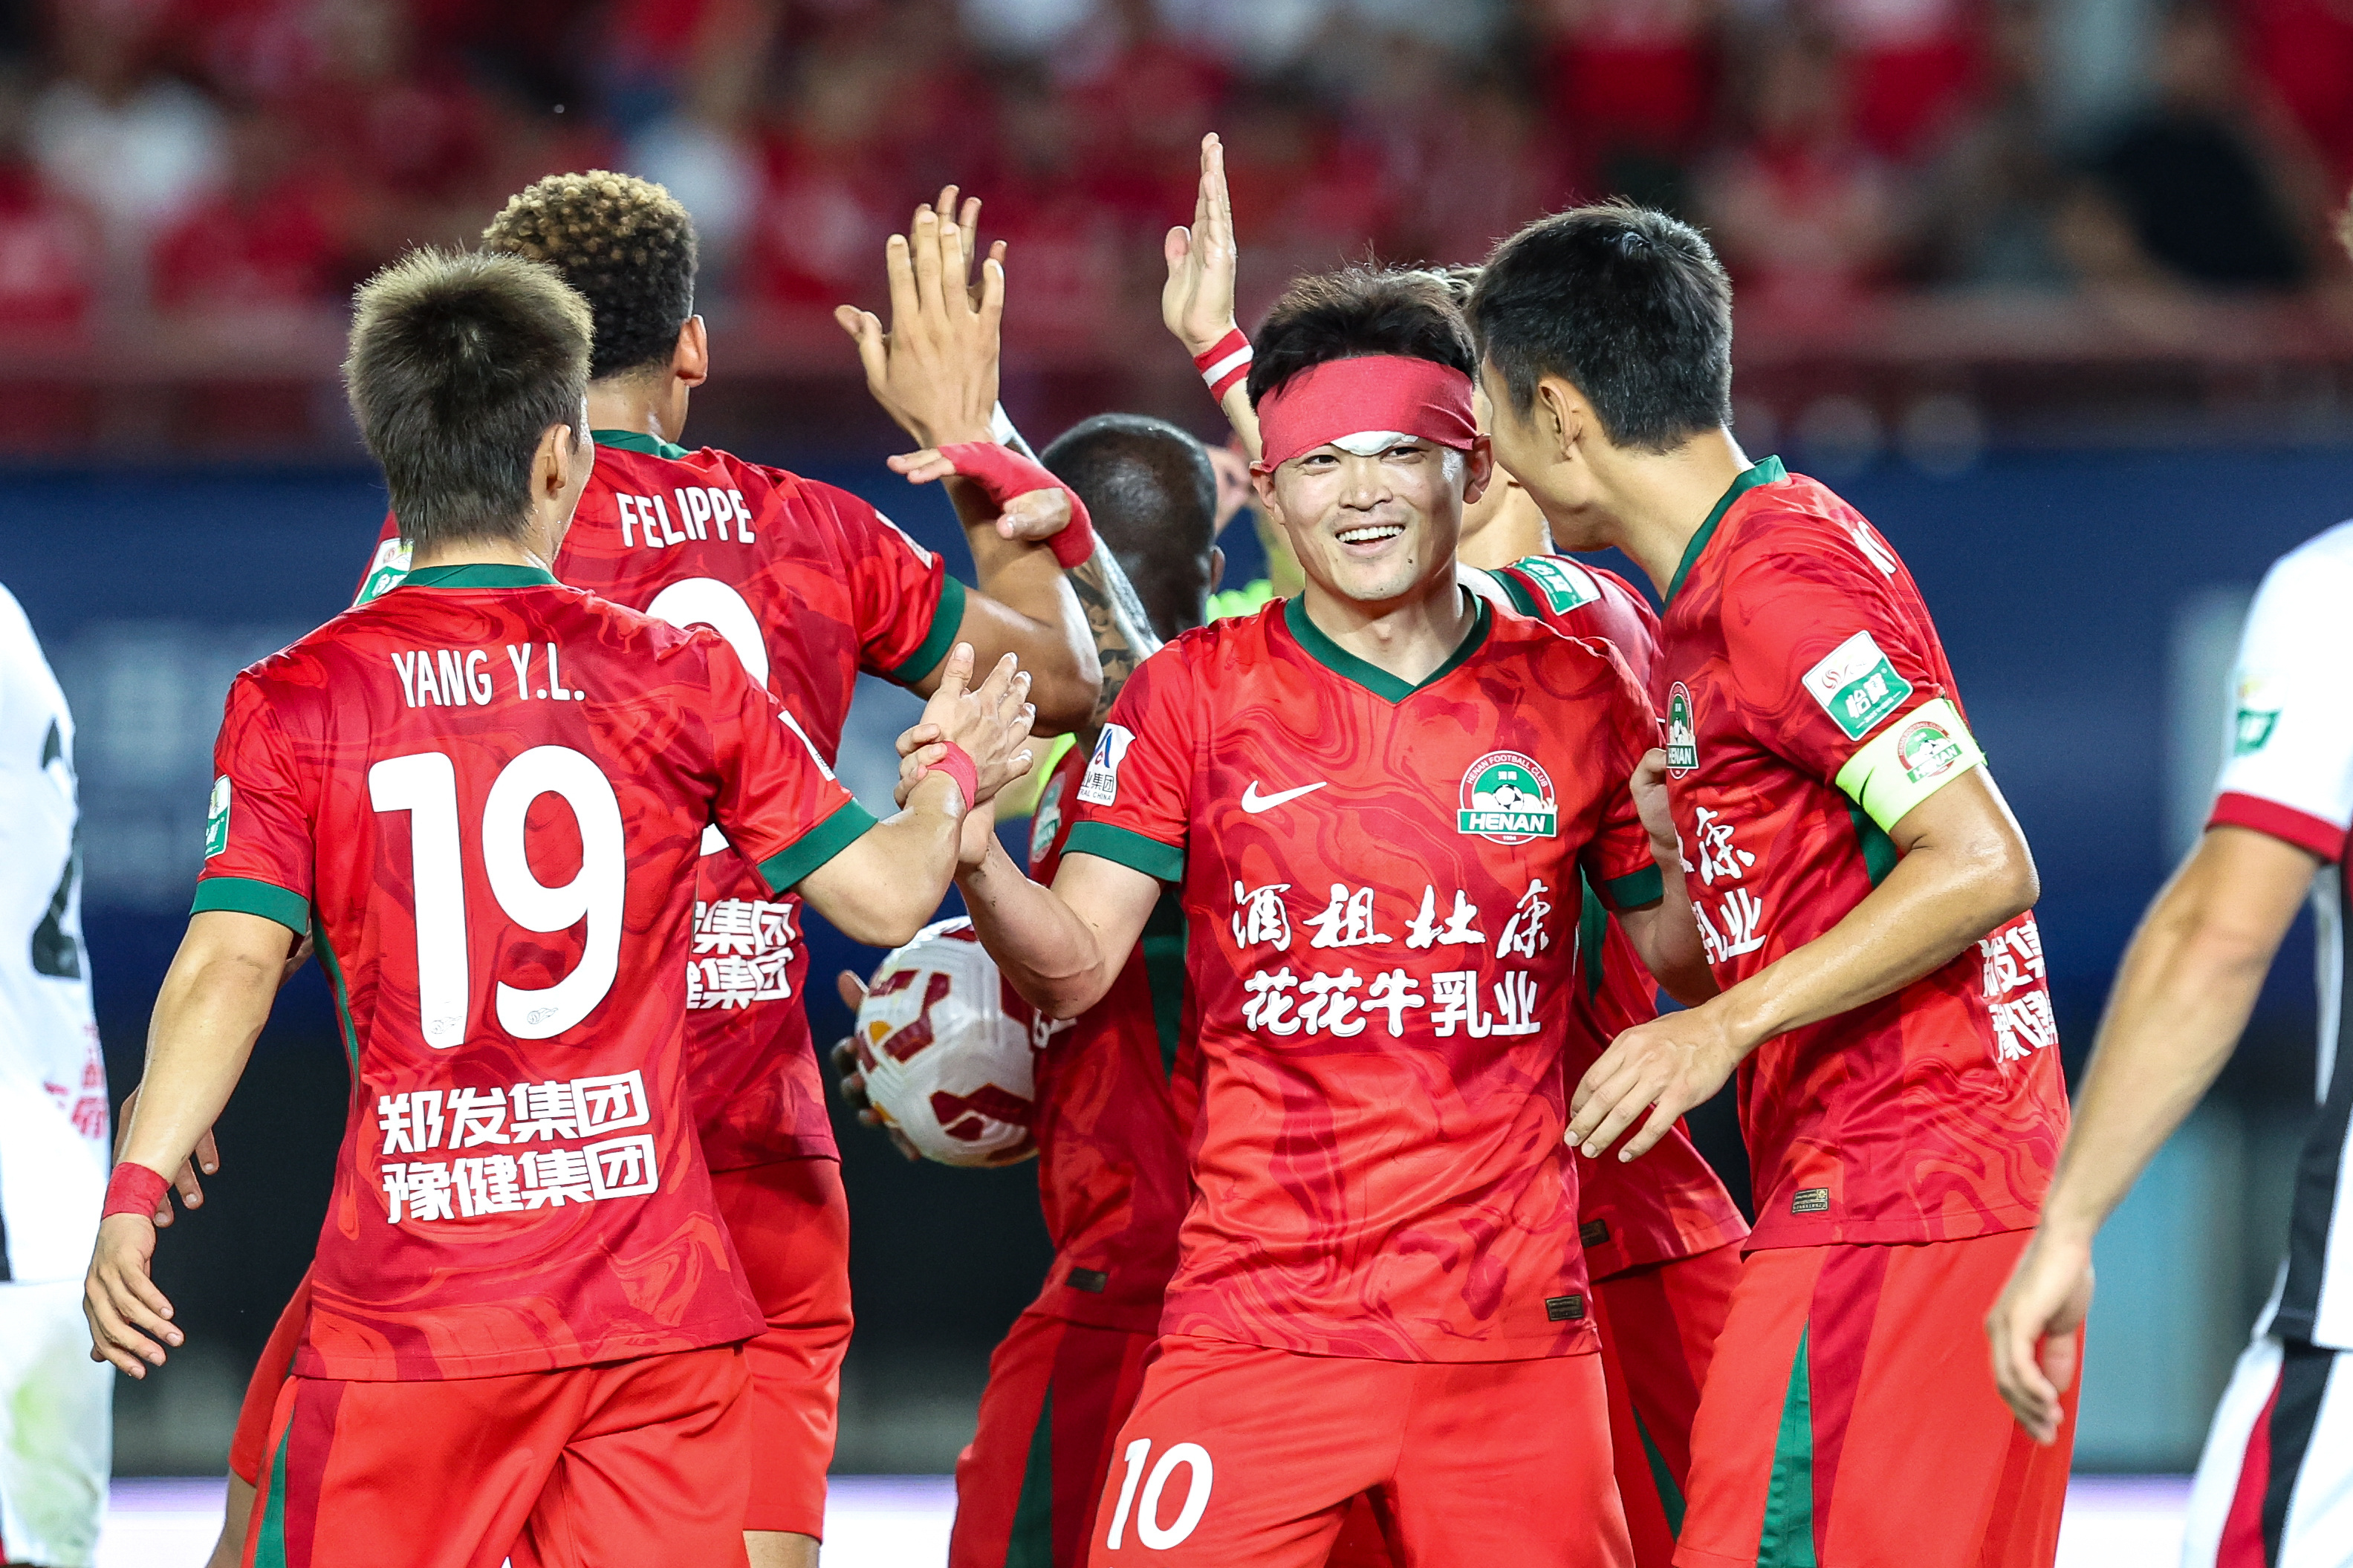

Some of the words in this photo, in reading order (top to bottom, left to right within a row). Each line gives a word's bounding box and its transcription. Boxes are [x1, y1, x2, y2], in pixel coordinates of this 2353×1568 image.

[616, 487, 755, 548] FELIPPE
[391, 649, 493, 708] YANG
[506, 642, 585, 701] Y.L.
[1080, 789, 1091, 797] RAL
[1092, 791, 1111, 801] CHINA
[1466, 760, 1490, 784] HENAN
[1488, 754, 1531, 770] FOOTBALL
[1531, 766, 1548, 788] CLUB
[1468, 813, 1546, 833] HENAN
[369, 745, 626, 1050] 19
[692, 897, 796, 955] 集团
[1232, 879, 1551, 959] 酒祖杜康
[1242, 966, 1541, 1038] 花花牛乳业
[377, 1069, 651, 1156] 郑发集团
[381, 1133, 659, 1224] 豫健集团
[1106, 1438, 1213, 1550] 10
